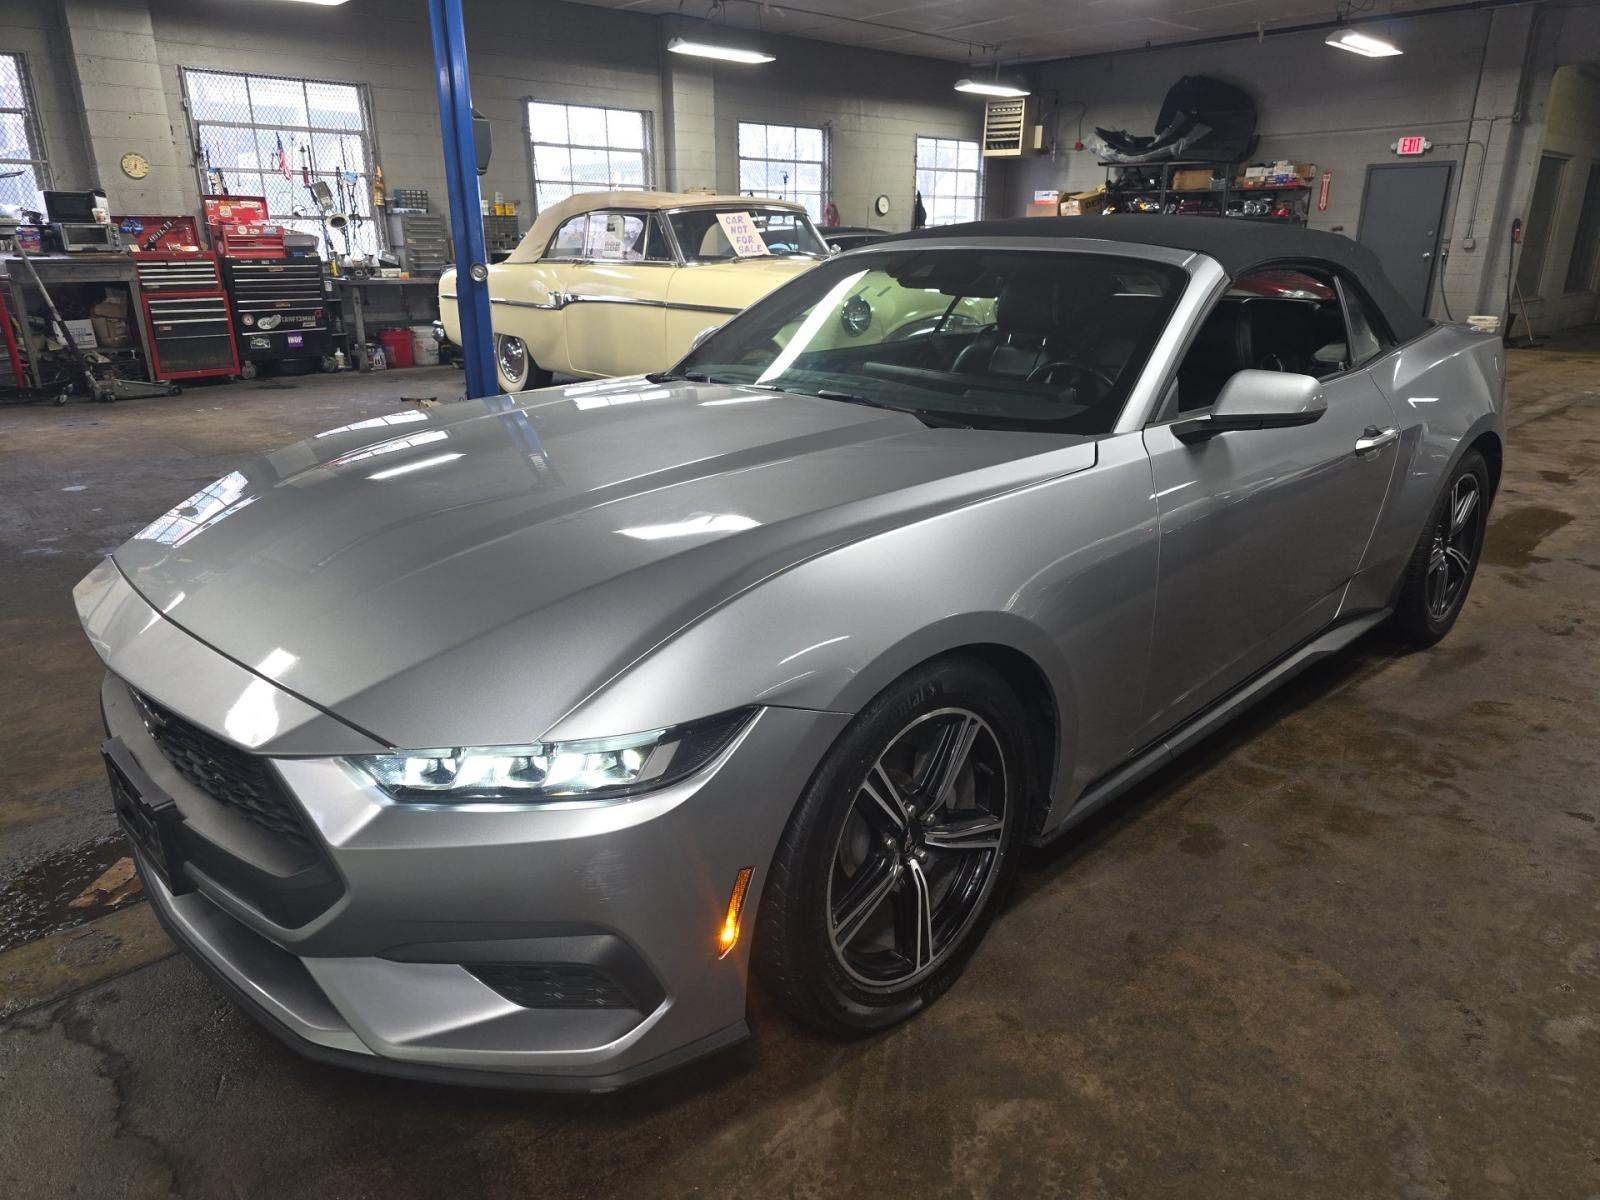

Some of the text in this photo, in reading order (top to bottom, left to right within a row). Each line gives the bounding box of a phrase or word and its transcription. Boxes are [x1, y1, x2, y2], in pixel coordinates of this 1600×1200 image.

[1401, 138, 1422, 152] EXIT
[725, 216, 744, 225] CAR
[730, 225, 747, 234] NOT
[736, 236, 753, 245] FOR
[738, 244, 763, 254] SALE
